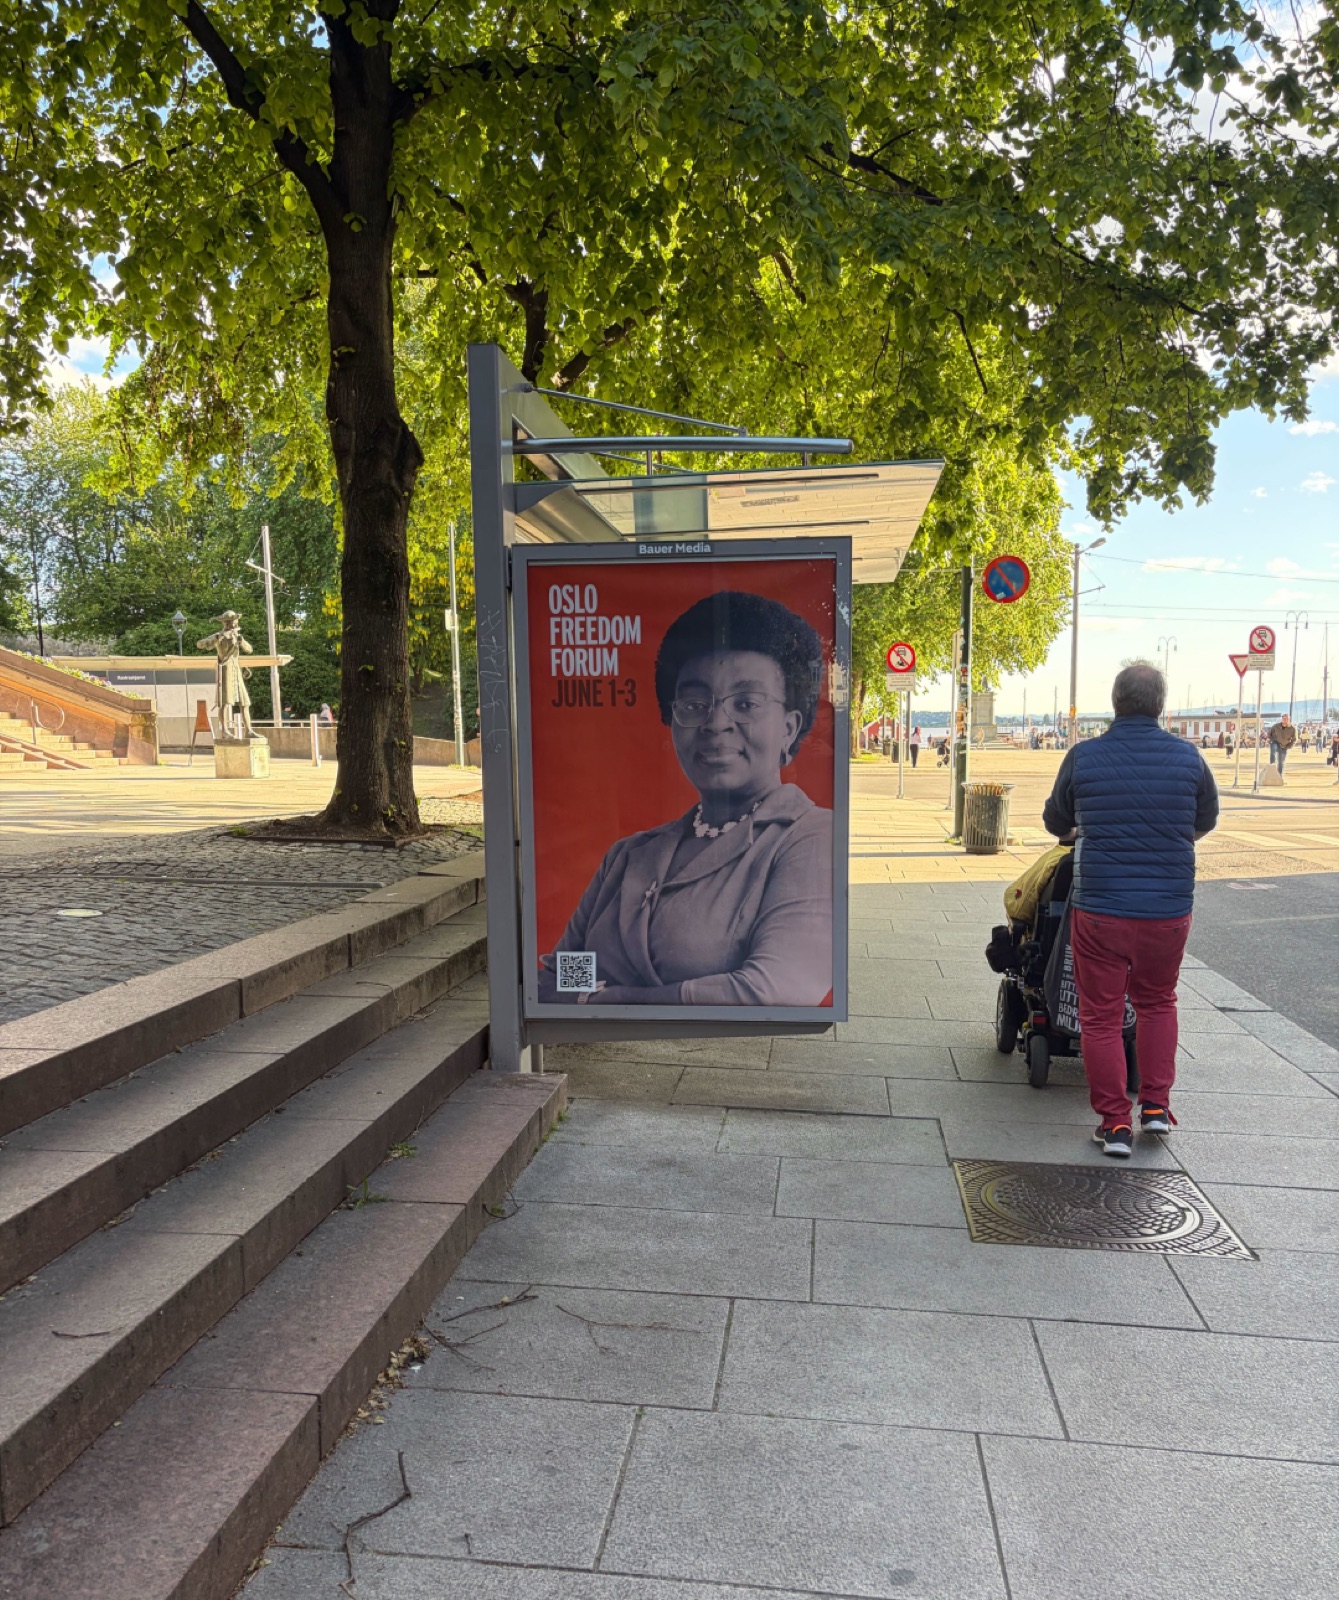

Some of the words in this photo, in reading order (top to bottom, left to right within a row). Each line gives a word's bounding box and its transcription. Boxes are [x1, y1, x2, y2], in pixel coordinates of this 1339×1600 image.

[639, 544, 673, 554] Bauer
[675, 542, 712, 553] Media
[548, 583, 598, 614] OSLO
[549, 615, 641, 646] FREEDOM
[550, 647, 619, 677] FORUM
[551, 679, 604, 708] JUNE
[608, 677, 637, 708] 1-3
[1058, 1003, 1079, 1018] BEDR
